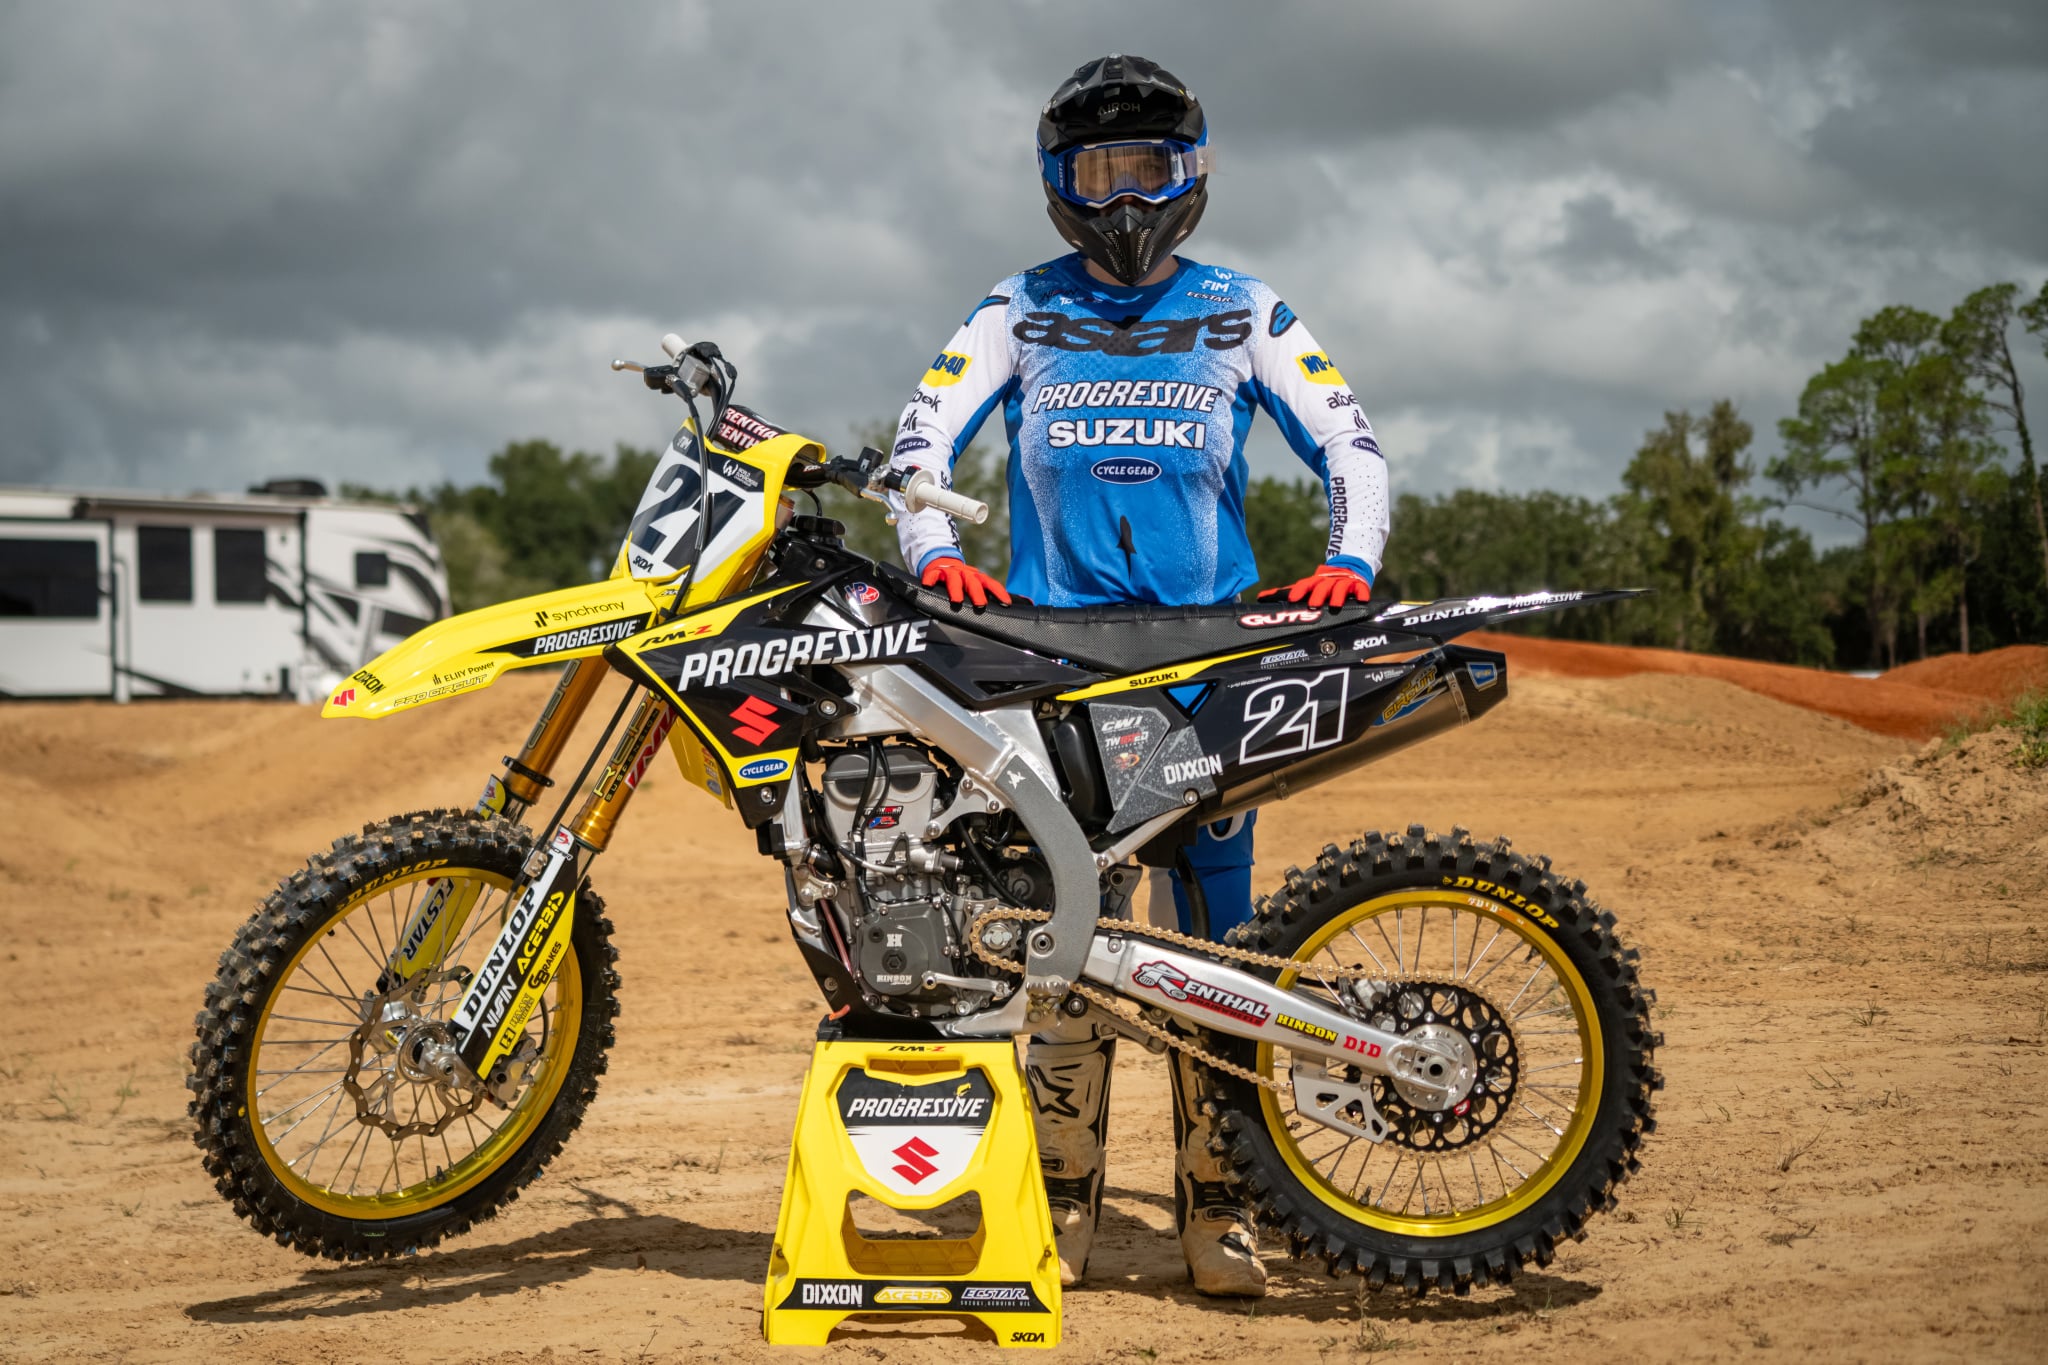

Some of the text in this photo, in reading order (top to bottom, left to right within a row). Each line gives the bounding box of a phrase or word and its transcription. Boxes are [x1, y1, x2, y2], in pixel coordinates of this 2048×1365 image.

[1201, 279, 1230, 293] FIM
[1302, 355, 1334, 375] WD-
[1031, 380, 1218, 414] PROGRESSIVE
[1326, 391, 1361, 409] albe
[725, 408, 779, 440] RENTHA
[1048, 418, 1207, 450] SUZUKI
[1097, 466, 1154, 475] CYCLE GEAR
[625, 463, 746, 572] 21
[552, 601, 625, 622] synchrony
[1240, 610, 1323, 627] GUTS
[533, 619, 638, 655] PROGRESSIVE
[639, 624, 713, 648] RM-Z
[1352, 634, 1389, 651] SKDA
[677, 620, 932, 693] PROGRESSIVE
[467, 661, 495, 675] Power
[1129, 671, 1180, 687] SUZUKI
[394, 673, 488, 708] PRO CIRCUIT
[1239, 667, 1350, 766] 21
[742, 762, 784, 776] CYCLE GEAR
[1163, 753, 1223, 785] DIXXON
[348, 859, 449, 902] DUNLOP
[1453, 876, 1560, 929] DUNLOP
[463, 887, 536, 1022] DUNLOP
[1276, 1013, 1339, 1043] HINSON
[1343, 1034, 1383, 1059] DID
[846, 1098, 985, 1118] PROGRESSIVE
[802, 1284, 862, 1305] DIXXON
[960, 1287, 1030, 1300] ECSTAR
[1010, 1332, 1045, 1344] SKDA
